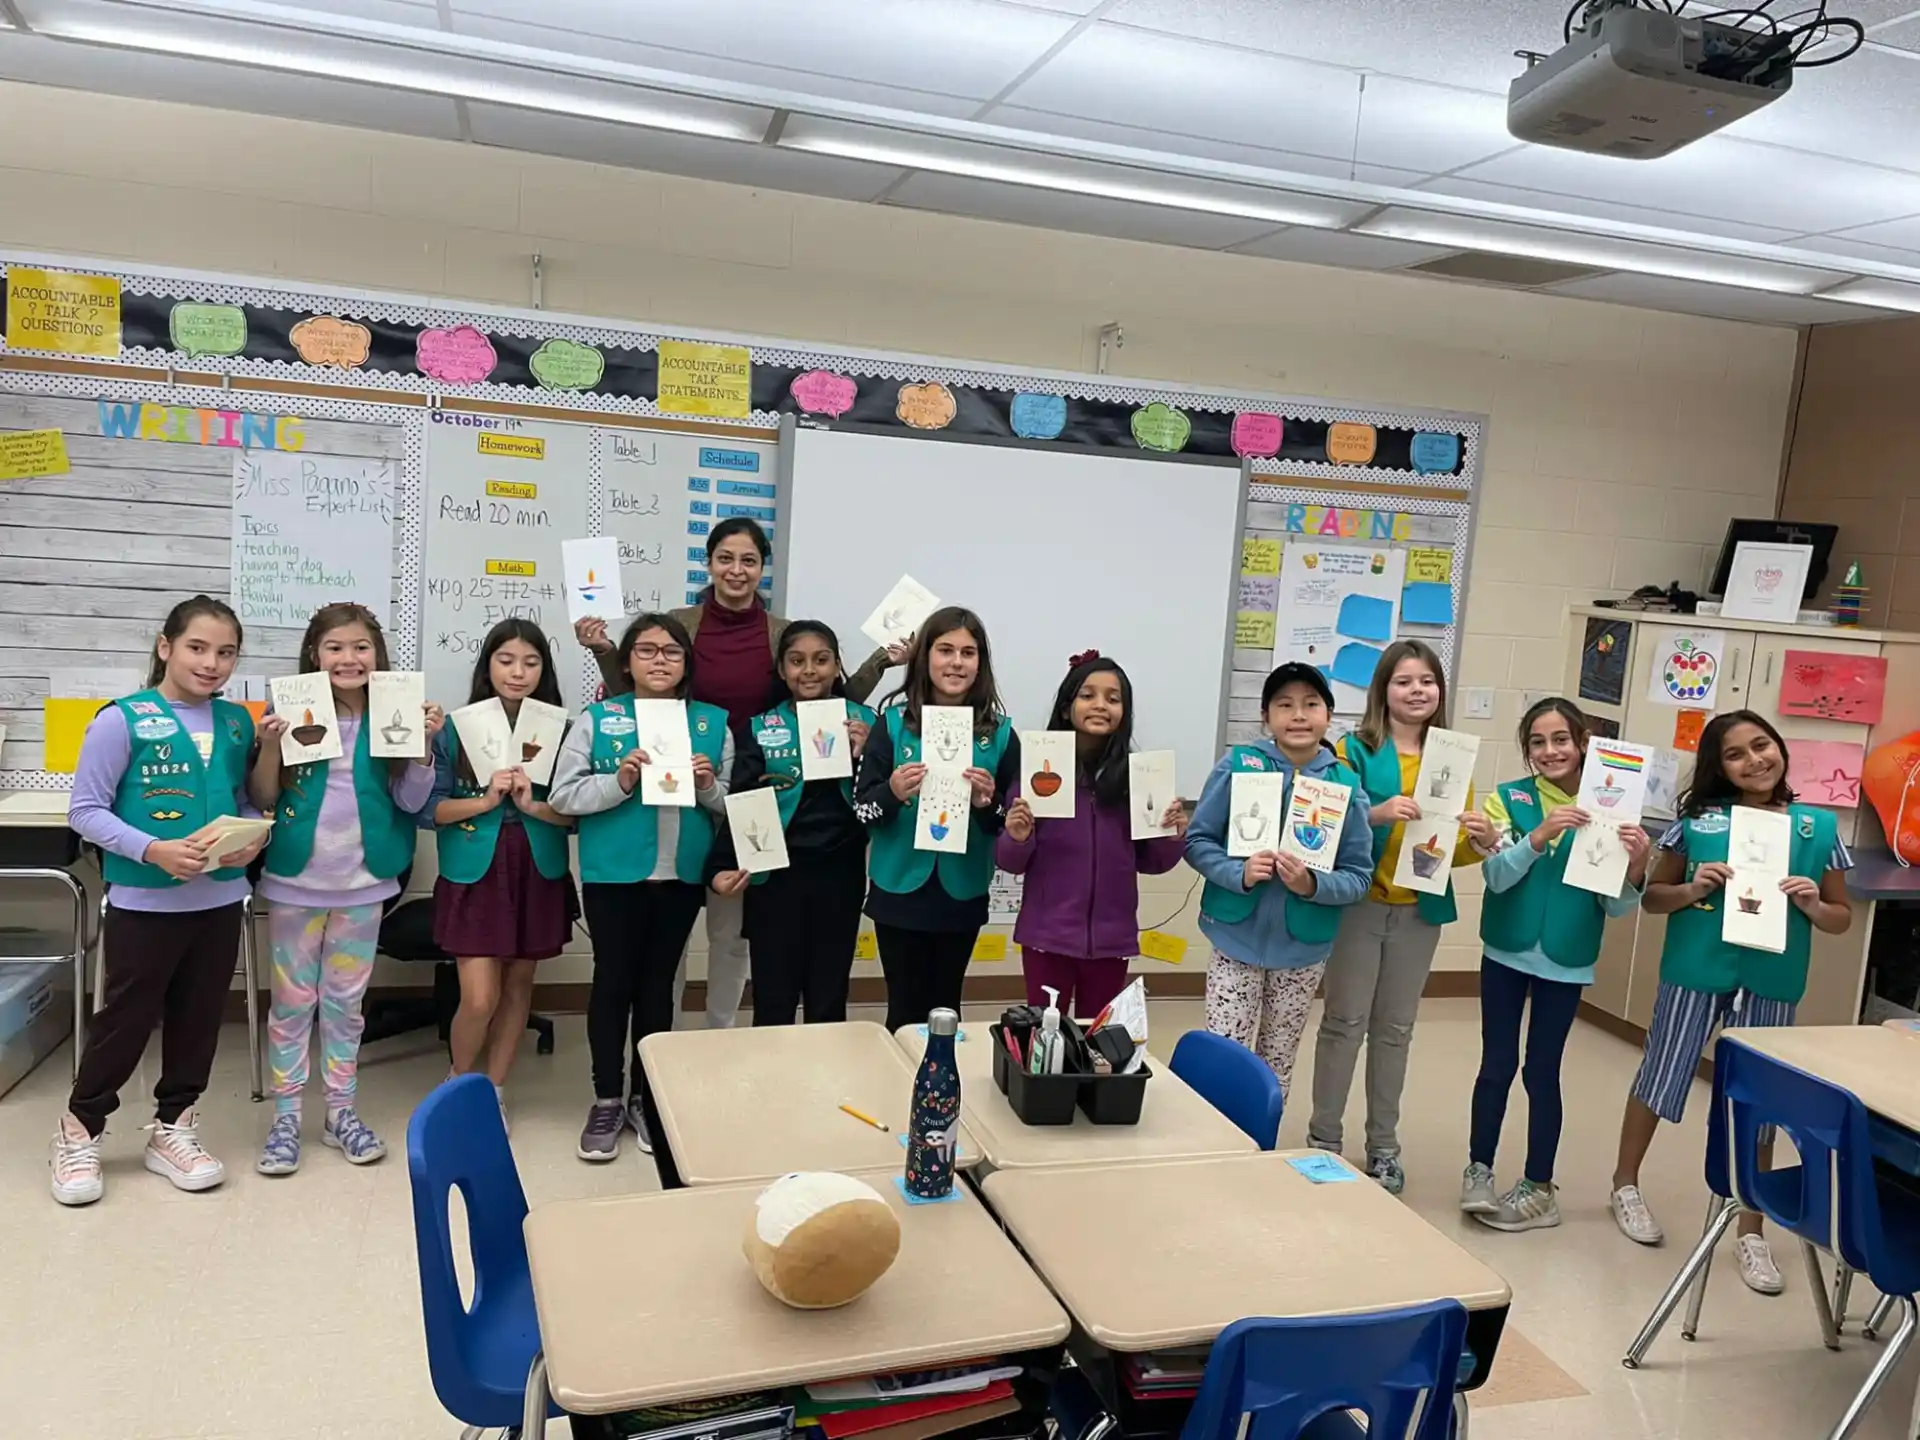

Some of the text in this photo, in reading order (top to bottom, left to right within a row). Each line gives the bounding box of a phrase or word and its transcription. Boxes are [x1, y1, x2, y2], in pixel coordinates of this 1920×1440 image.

[11, 286, 115, 308] ACCOUNTABLE
[44, 304, 80, 320] TALK
[21, 317, 104, 337] QUESTIONS
[662, 357, 747, 375] ACCOUNTABLE
[688, 373, 719, 386] TALK
[97, 400, 305, 452] WRITING
[431, 411, 500, 429] October
[480, 436, 542, 455] Homework
[608, 434, 641, 458] Table
[705, 451, 754, 467] Schedule
[245, 463, 291, 497] Miss
[492, 482, 532, 499] Reading
[608, 489, 659, 511] Table 2
[306, 496, 386, 518] Expert List
[440, 495, 481, 522] Read
[489, 502, 510, 526] 20
[239, 514, 279, 536] Topics
[1286, 504, 1411, 542] READING
[241, 540, 299, 564] teaching
[653, 543, 662, 561] 3
[300, 557, 323, 572] dog
[498, 561, 524, 573] Math
[319, 569, 356, 587] beach
[650, 590, 661, 610] 4
[482, 604, 542, 627] EVEN
